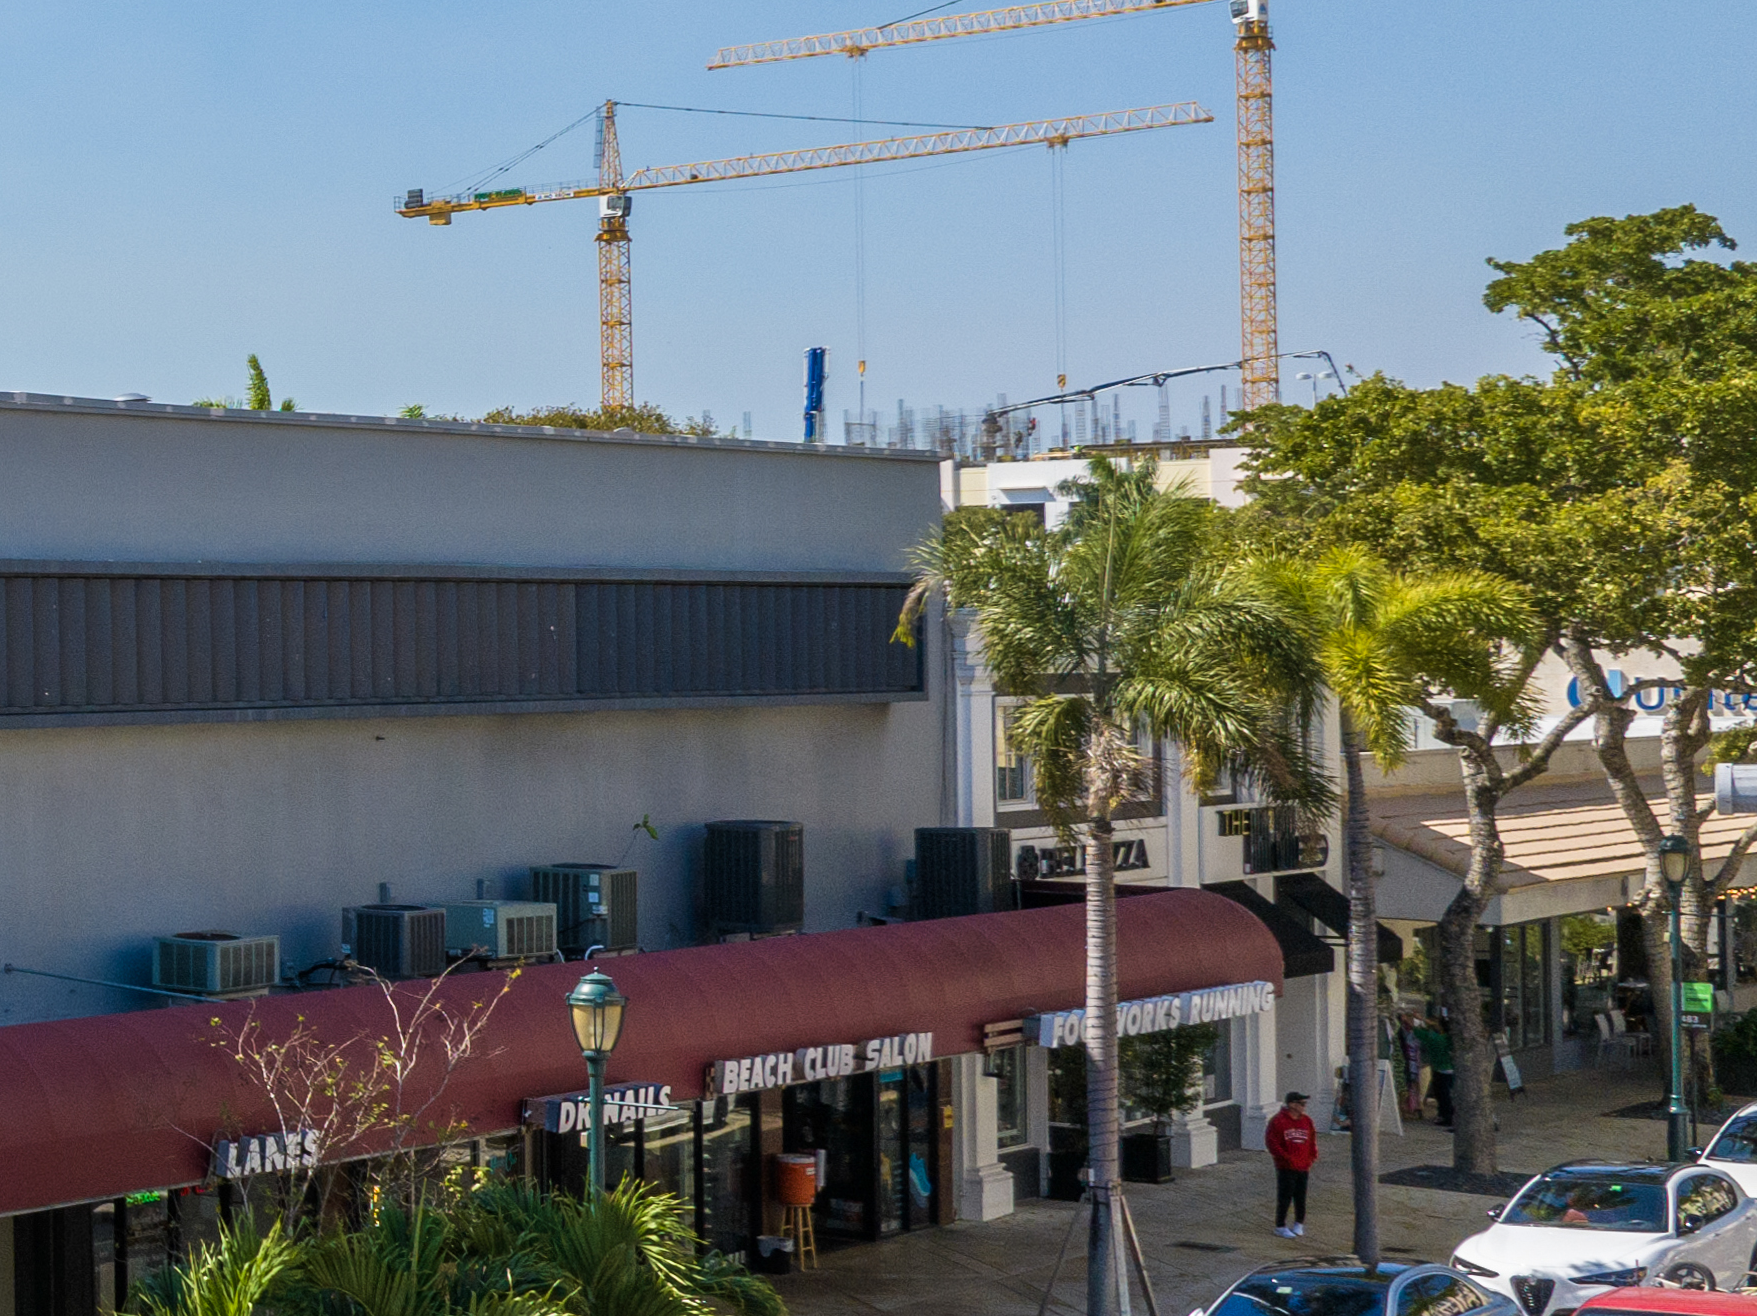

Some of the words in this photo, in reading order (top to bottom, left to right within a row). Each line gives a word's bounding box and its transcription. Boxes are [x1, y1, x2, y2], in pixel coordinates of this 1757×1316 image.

[1053, 997, 1181, 1048] FOOORKS
[1189, 982, 1274, 1026] RUNNING
[723, 1052, 794, 1094] BEACH
[804, 1044, 854, 1081] CLUB
[865, 1032, 933, 1072] SALON
[603, 1085, 672, 1126] NAILS
[227, 1128, 321, 1178] LANES
